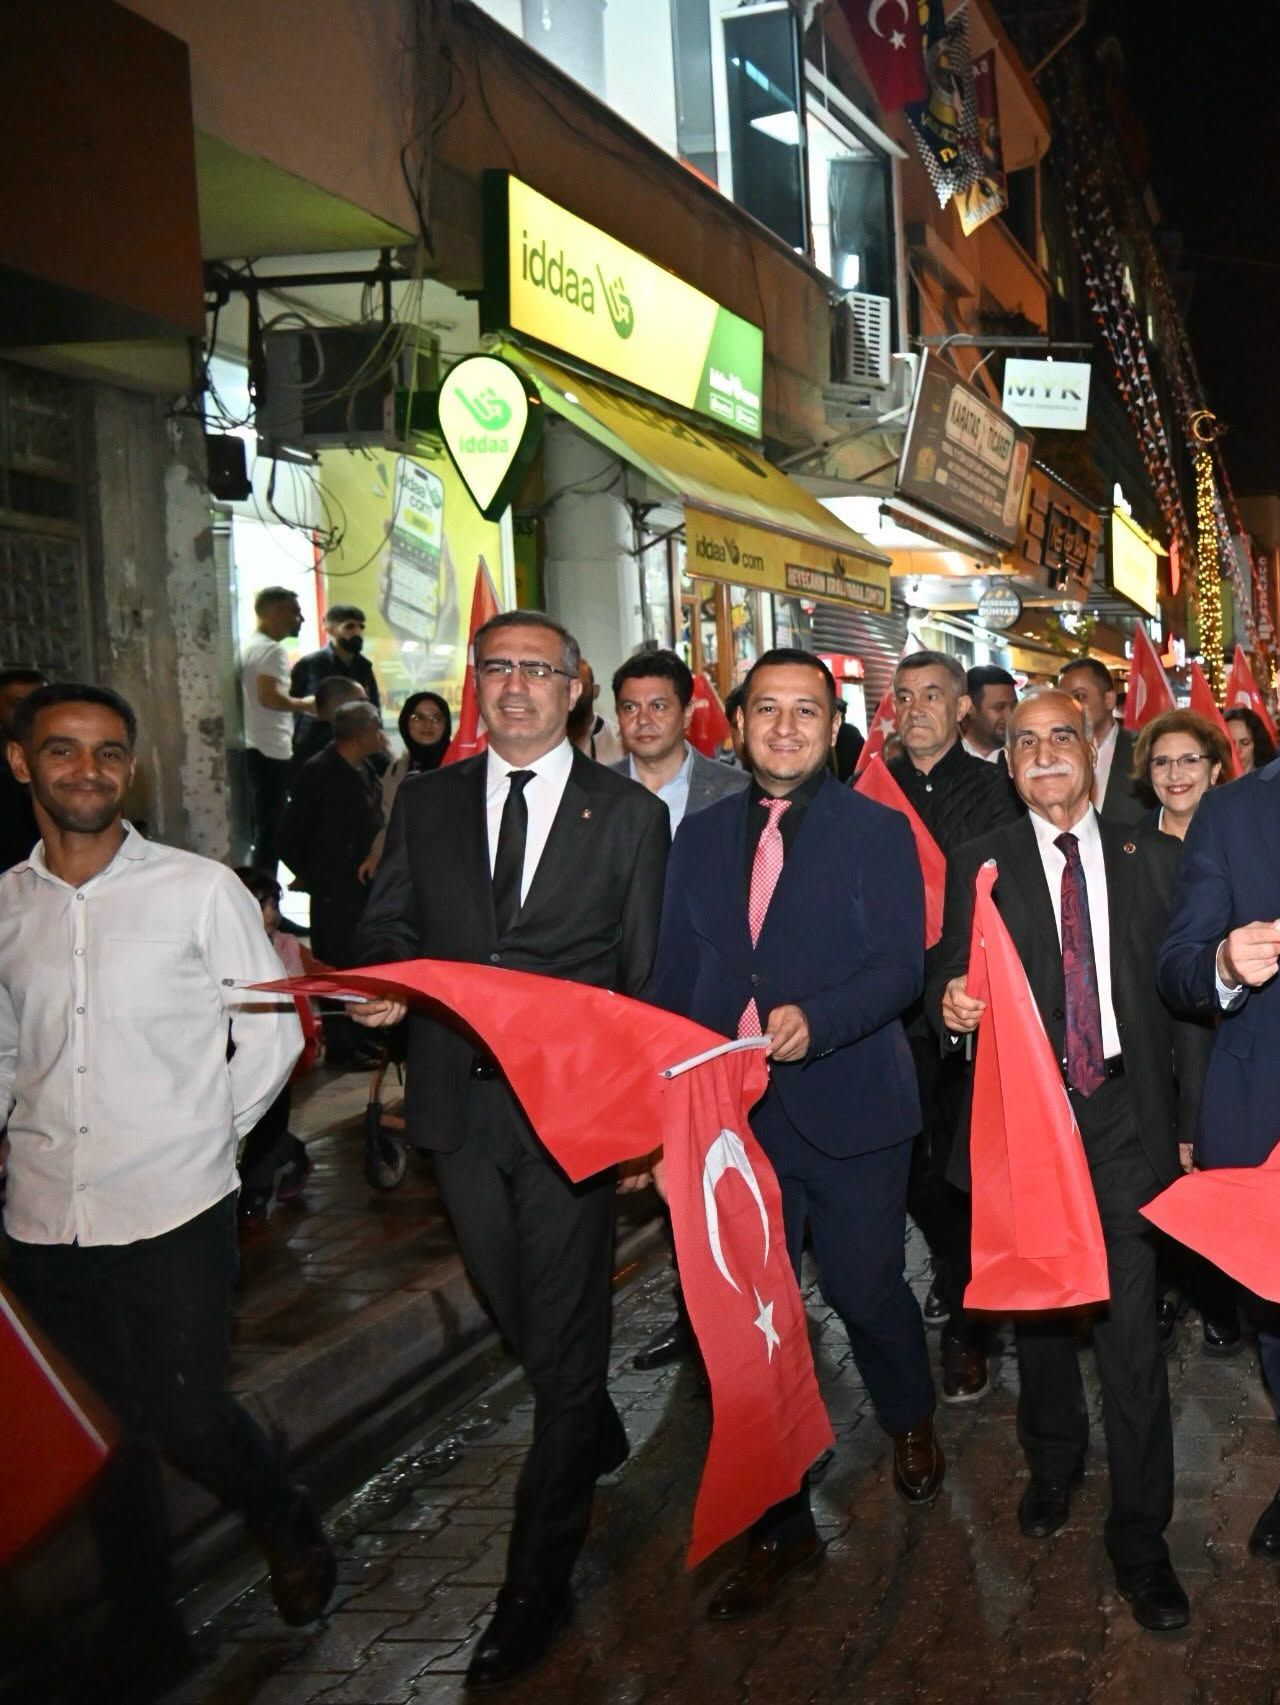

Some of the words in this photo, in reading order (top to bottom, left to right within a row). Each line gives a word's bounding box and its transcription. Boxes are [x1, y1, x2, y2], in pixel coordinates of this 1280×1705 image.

[522, 230, 595, 315] iddaa
[459, 435, 510, 454] iddaa
[695, 535, 726, 562] iddaa
[742, 552, 764, 571] com
